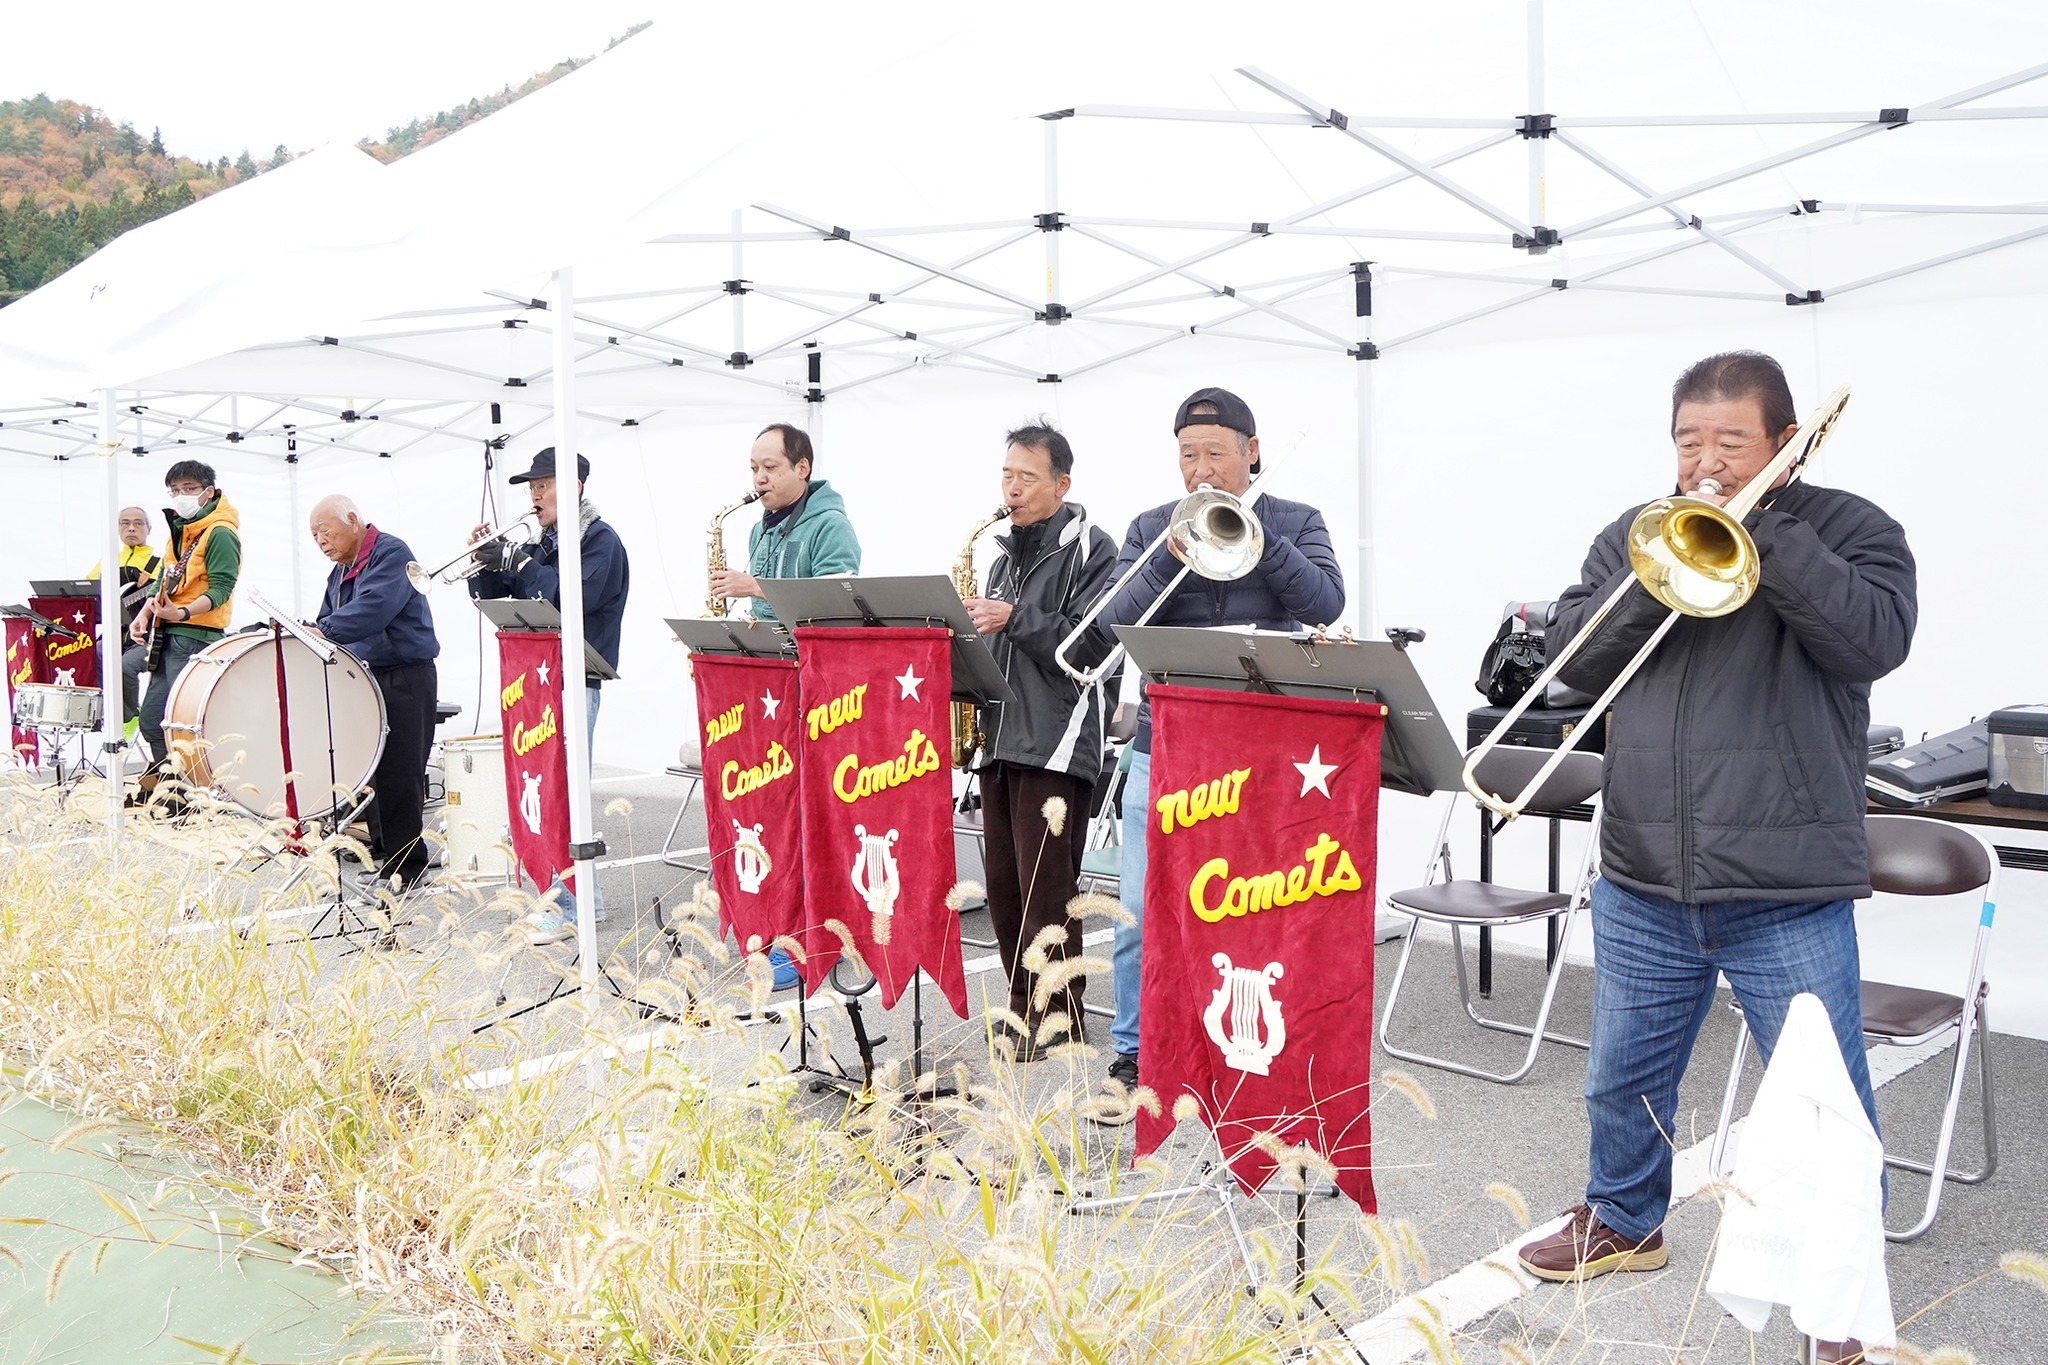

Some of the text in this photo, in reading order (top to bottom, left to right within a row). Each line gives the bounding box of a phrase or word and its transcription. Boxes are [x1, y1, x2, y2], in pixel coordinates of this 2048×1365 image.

[46, 632, 93, 661] Comets
[512, 703, 557, 756] Comets
[706, 703, 745, 747] new
[806, 683, 868, 741] new
[721, 740, 794, 801] Comets
[833, 728, 940, 804] Comets
[1156, 767, 1252, 835] new
[1188, 832, 1362, 923] Comets
